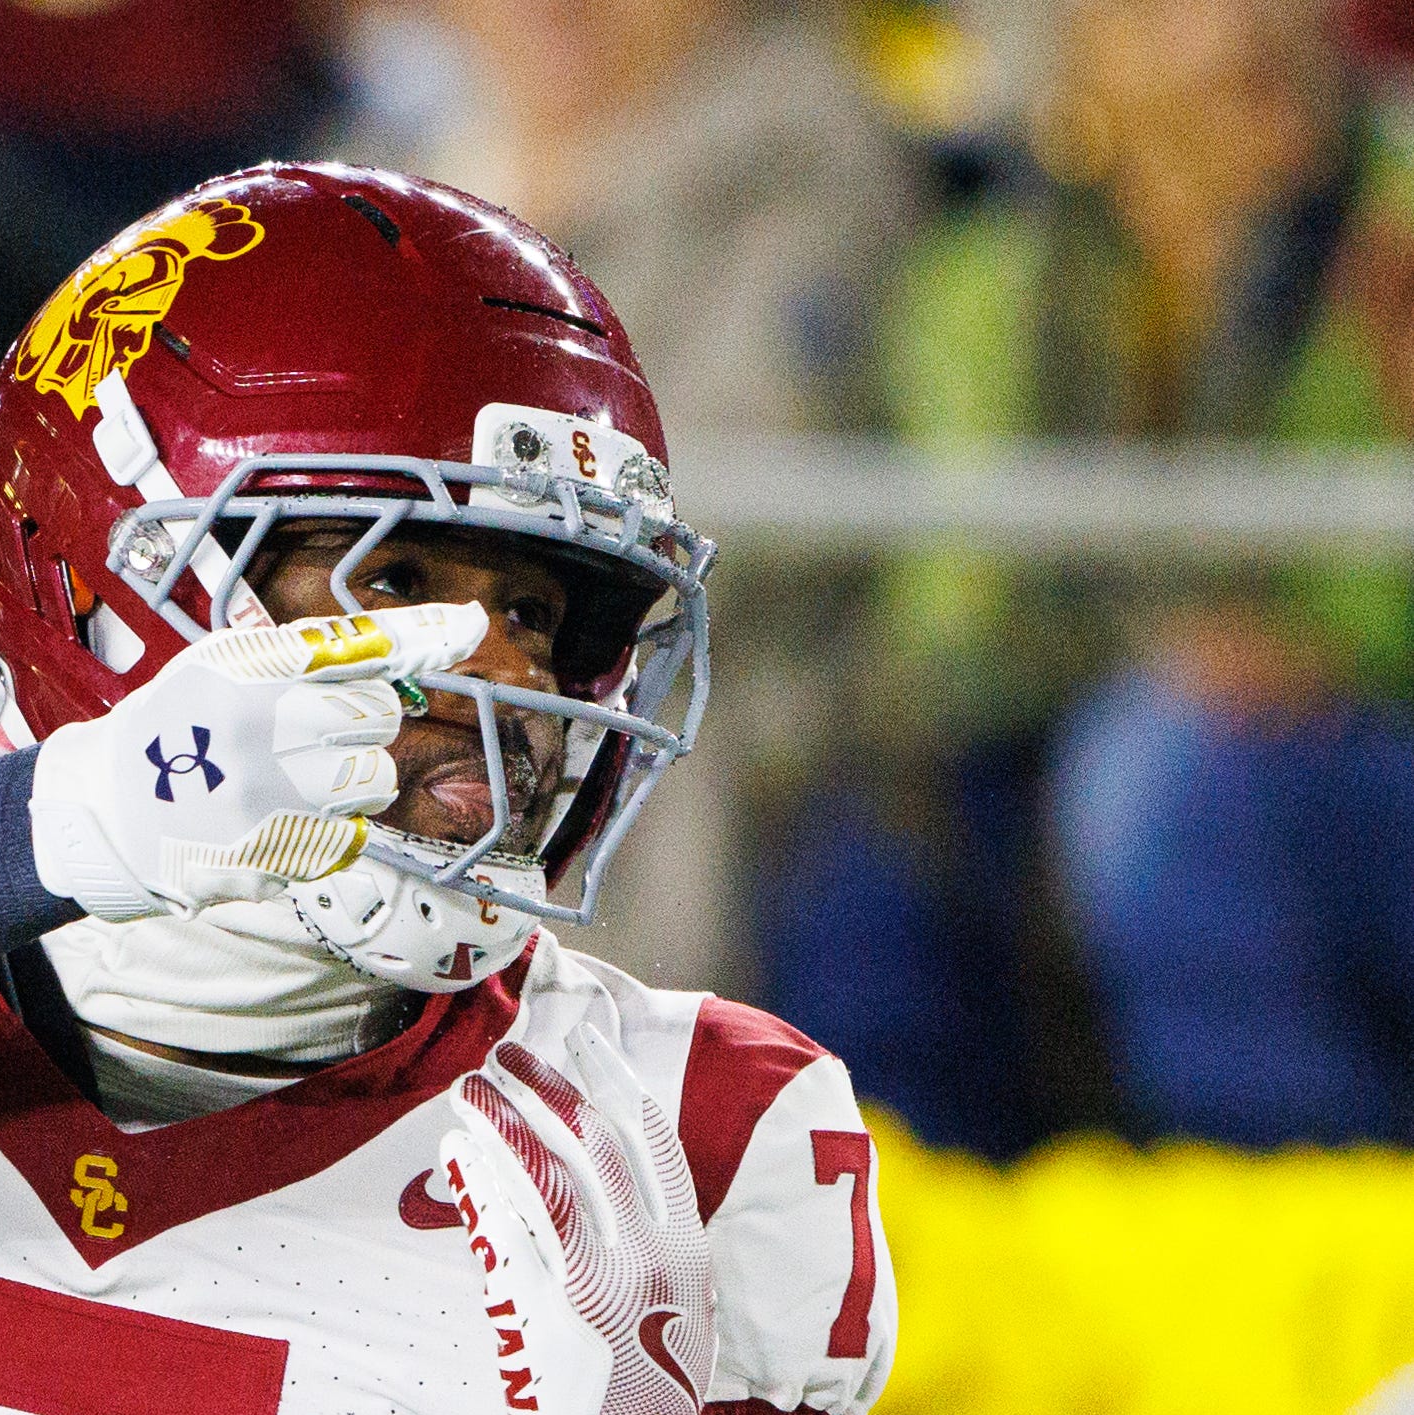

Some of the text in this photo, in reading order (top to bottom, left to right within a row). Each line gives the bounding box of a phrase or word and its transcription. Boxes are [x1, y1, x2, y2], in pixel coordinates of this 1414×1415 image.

[572, 430, 597, 479] SC
[70, 1154, 128, 1239] SC
[810, 1129, 877, 1359] 7
